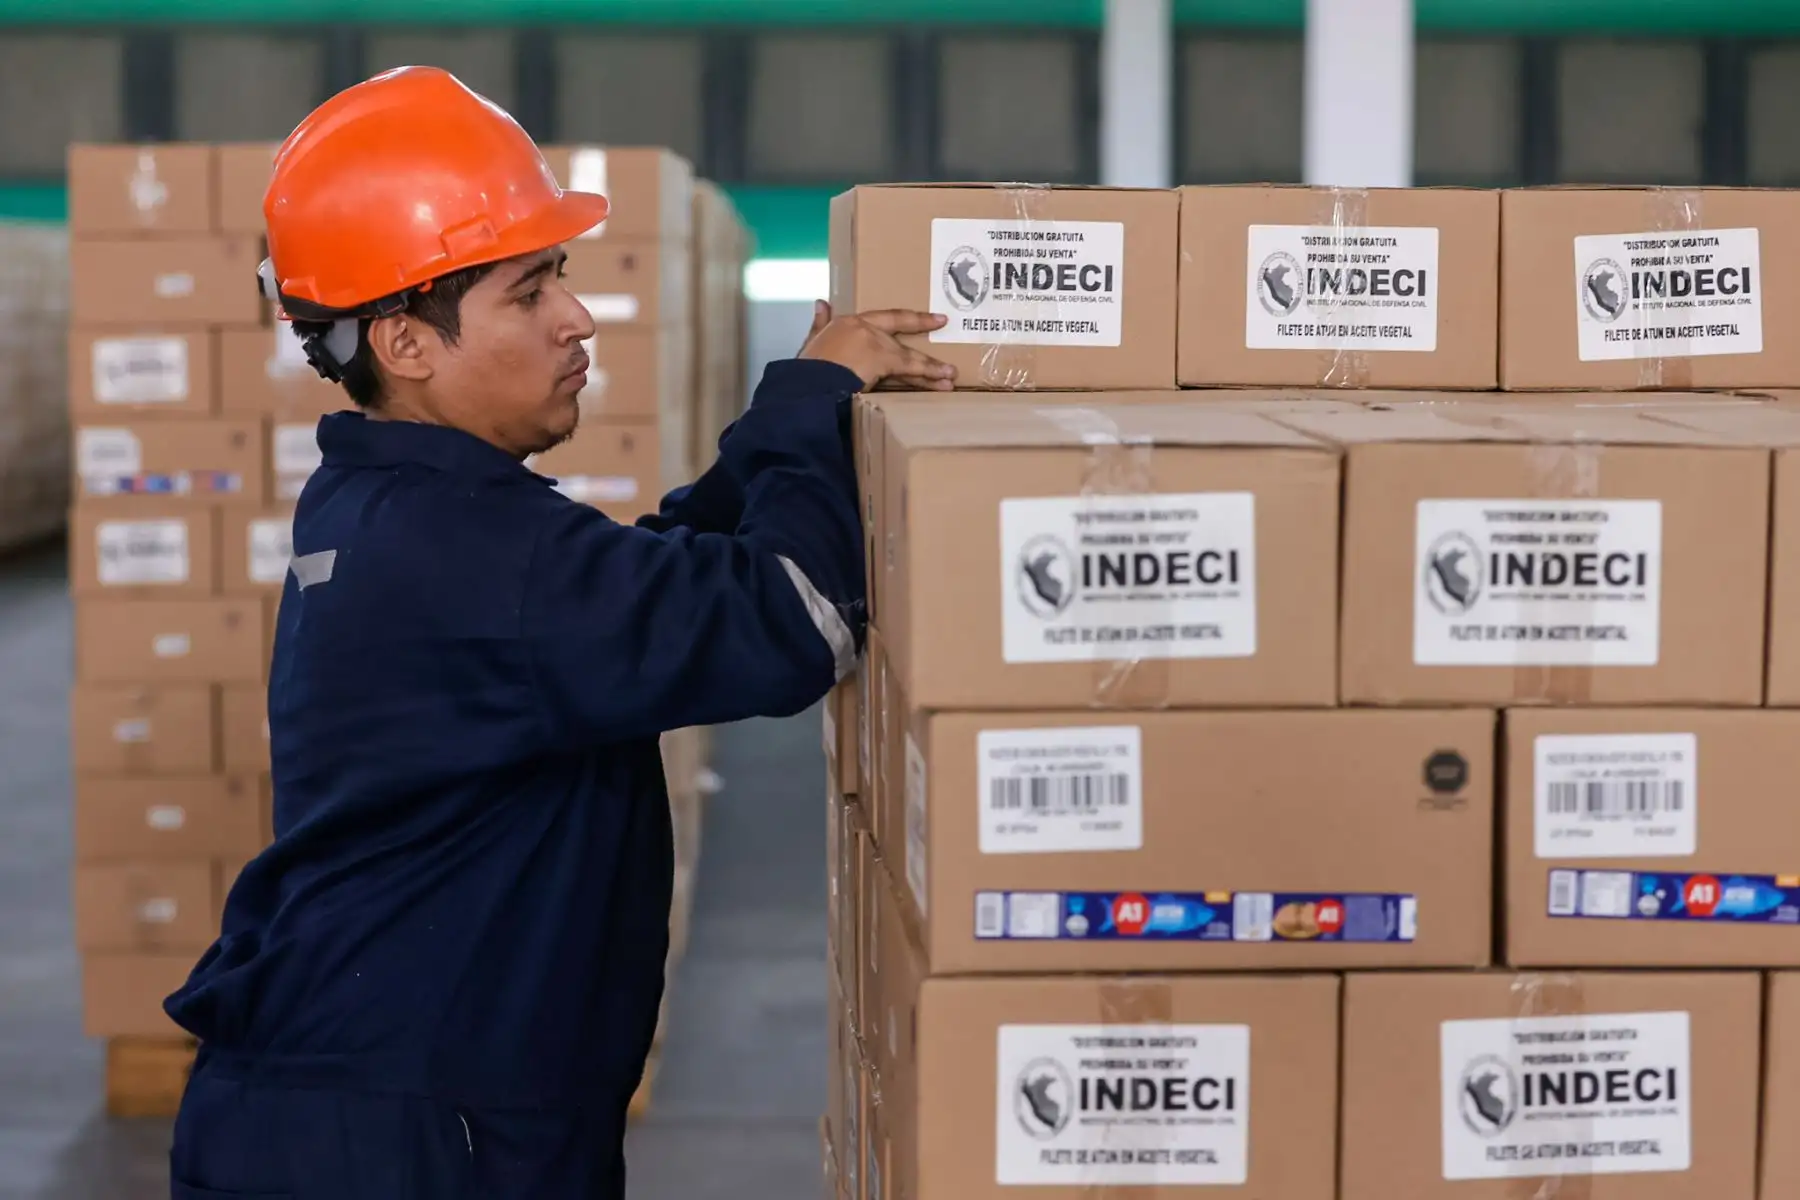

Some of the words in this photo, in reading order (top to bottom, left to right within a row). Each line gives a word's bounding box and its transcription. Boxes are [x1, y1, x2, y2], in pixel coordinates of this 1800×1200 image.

[1046, 232, 1084, 242] GRATUITA
[1359, 237, 1397, 247] GRATUITA
[1682, 237, 1719, 248] GRATUITA
[993, 248, 1034, 257] PROHIBIDA
[1036, 249, 1046, 258] SU
[1307, 254, 1348, 263] PROHIBDA
[1350, 254, 1360, 263] SU
[993, 262, 1113, 292] INDECI
[1307, 268, 1426, 296] INDECI
[1631, 267, 1751, 299] INDECI
[962, 319, 988, 331] FILETE
[989, 319, 999, 331] DE
[1001, 320, 1023, 331] ATUN
[1024, 320, 1034, 332] EN
[1036, 320, 1063, 332] ACEITE
[1066, 321, 1099, 333] VEGETAL
[1277, 324, 1302, 336] FILETE
[1304, 325, 1314, 336] DE
[1338, 325, 1349, 337] EN
[1350, 326, 1377, 337] ACEITE
[1379, 326, 1412, 338] VEGETAL
[1605, 328, 1630, 341] FILETE
[1632, 328, 1641, 340] DE
[1643, 327, 1664, 339] ATUN
[1666, 327, 1675, 338] EN
[1677, 325, 1704, 338] ACEITE
[1706, 324, 1740, 336] VEGETAL
[1082, 550, 1239, 588] INDECI
[1490, 552, 1646, 586] INDECI
[1689, 884, 1715, 904] A1
[1117, 902, 1143, 922] A1
[1079, 1077, 1235, 1111] INDECI
[1523, 1068, 1676, 1107] INDECI
